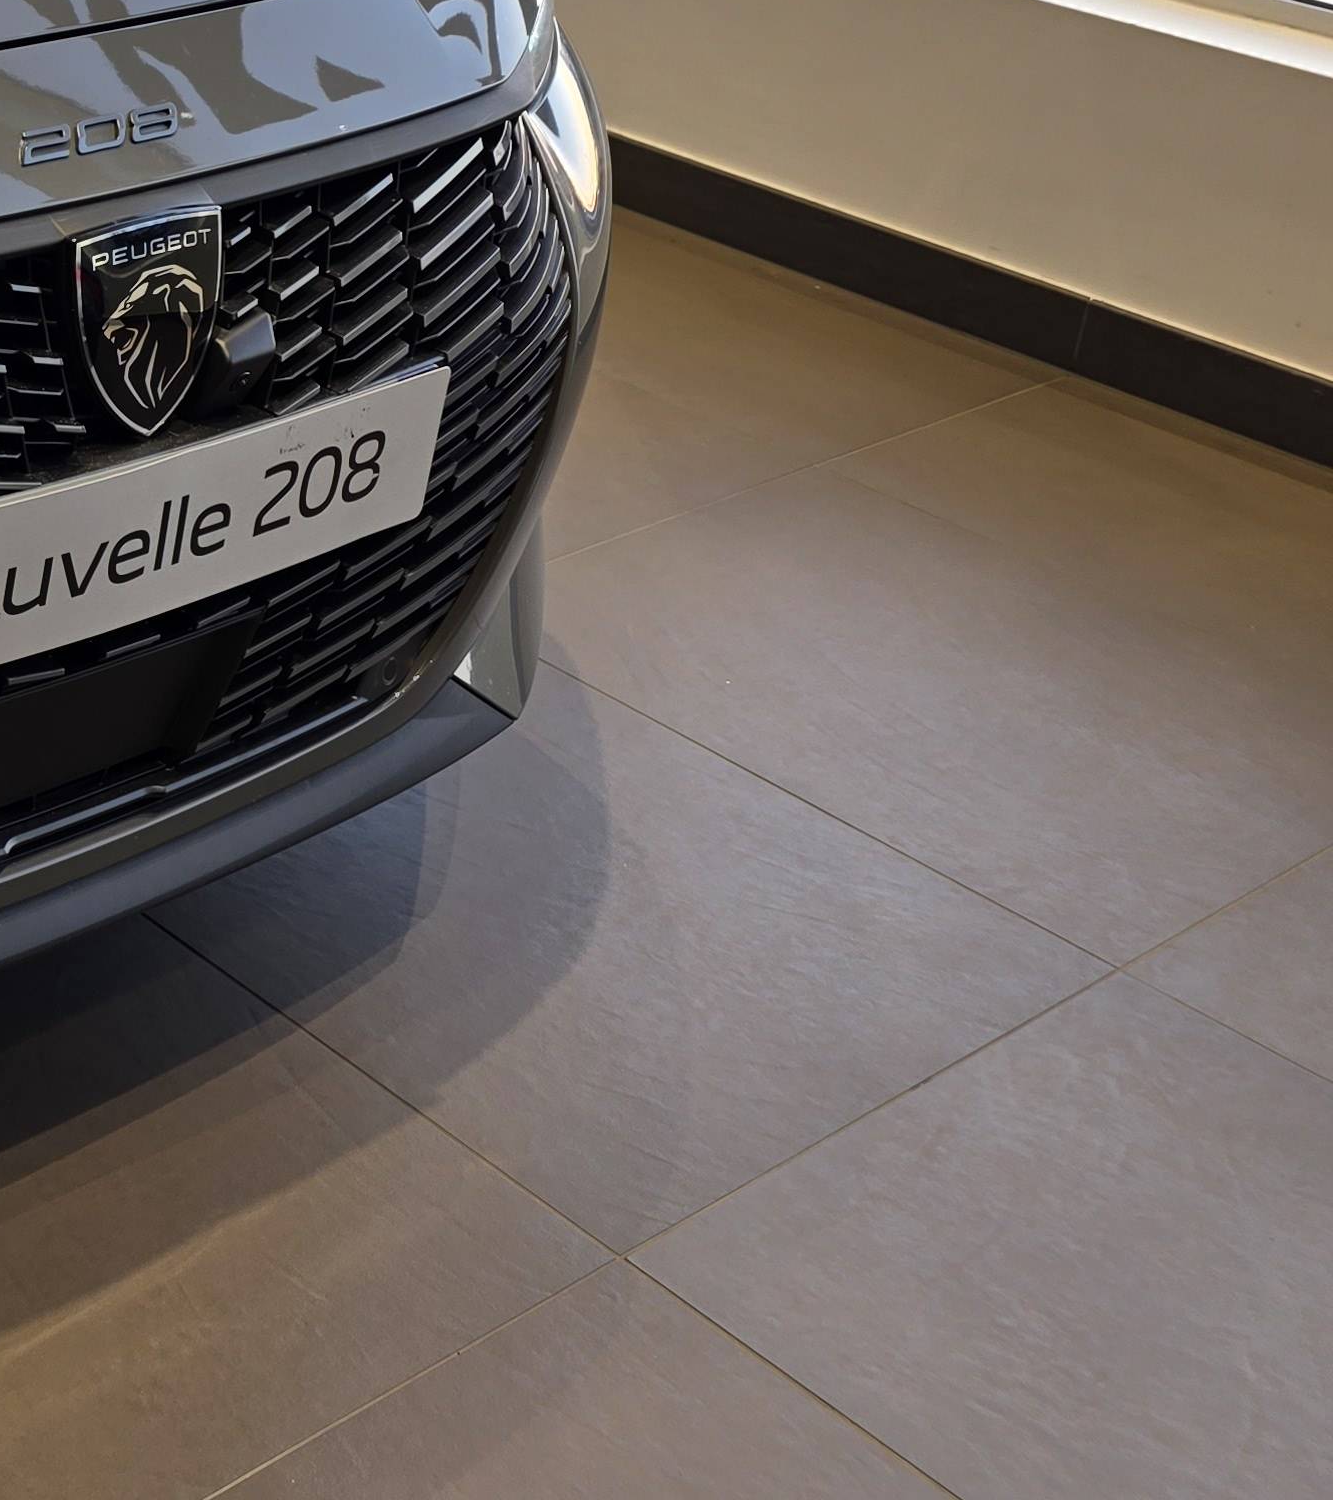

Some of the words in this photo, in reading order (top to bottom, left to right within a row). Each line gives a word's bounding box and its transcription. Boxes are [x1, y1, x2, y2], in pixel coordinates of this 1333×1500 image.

[20, 102, 178, 167] 208
[91, 228, 212, 272] PEUGEOT
[252, 430, 386, 537] 208
